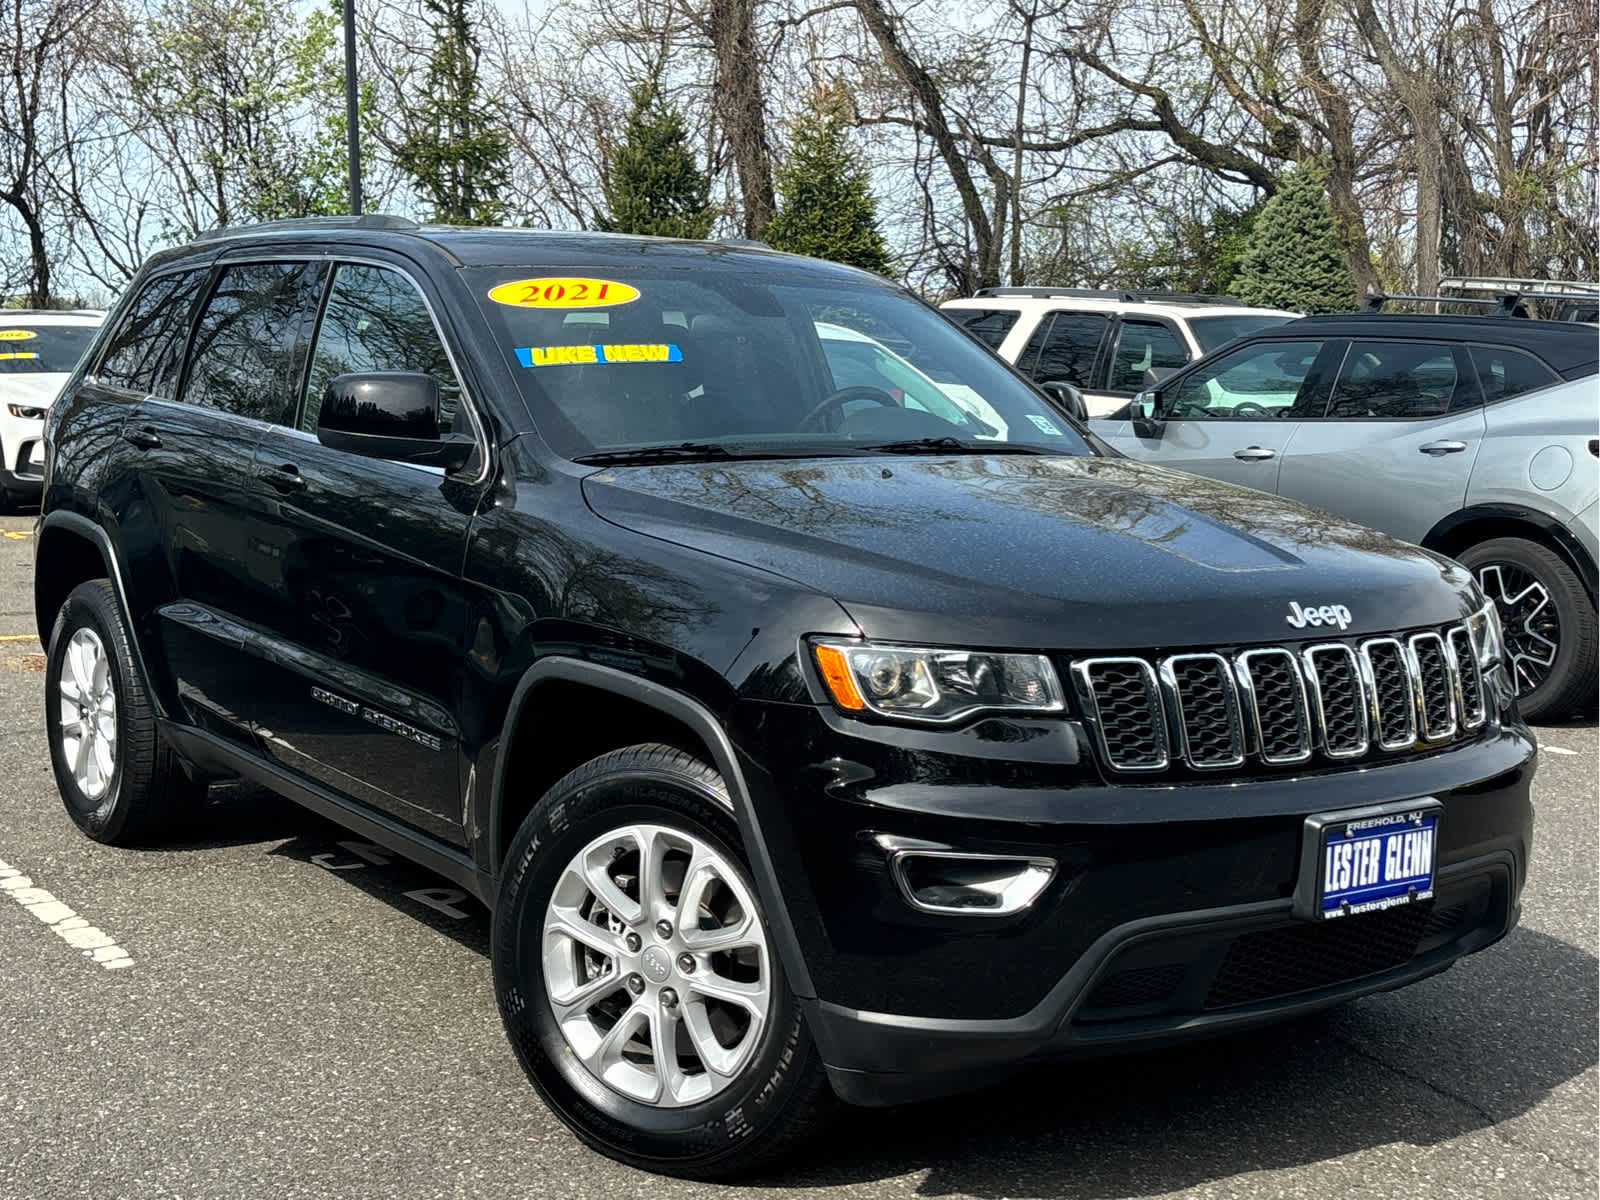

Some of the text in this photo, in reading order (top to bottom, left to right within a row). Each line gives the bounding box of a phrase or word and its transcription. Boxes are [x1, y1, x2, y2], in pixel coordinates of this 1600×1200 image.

[520, 283, 609, 303] 2021
[531, 344, 670, 366] LIKE NEW
[1286, 601, 1352, 630] Jeep
[1347, 811, 1423, 831] FREEHOLD, NJ
[1324, 829, 1433, 893] LESTER GLENN
